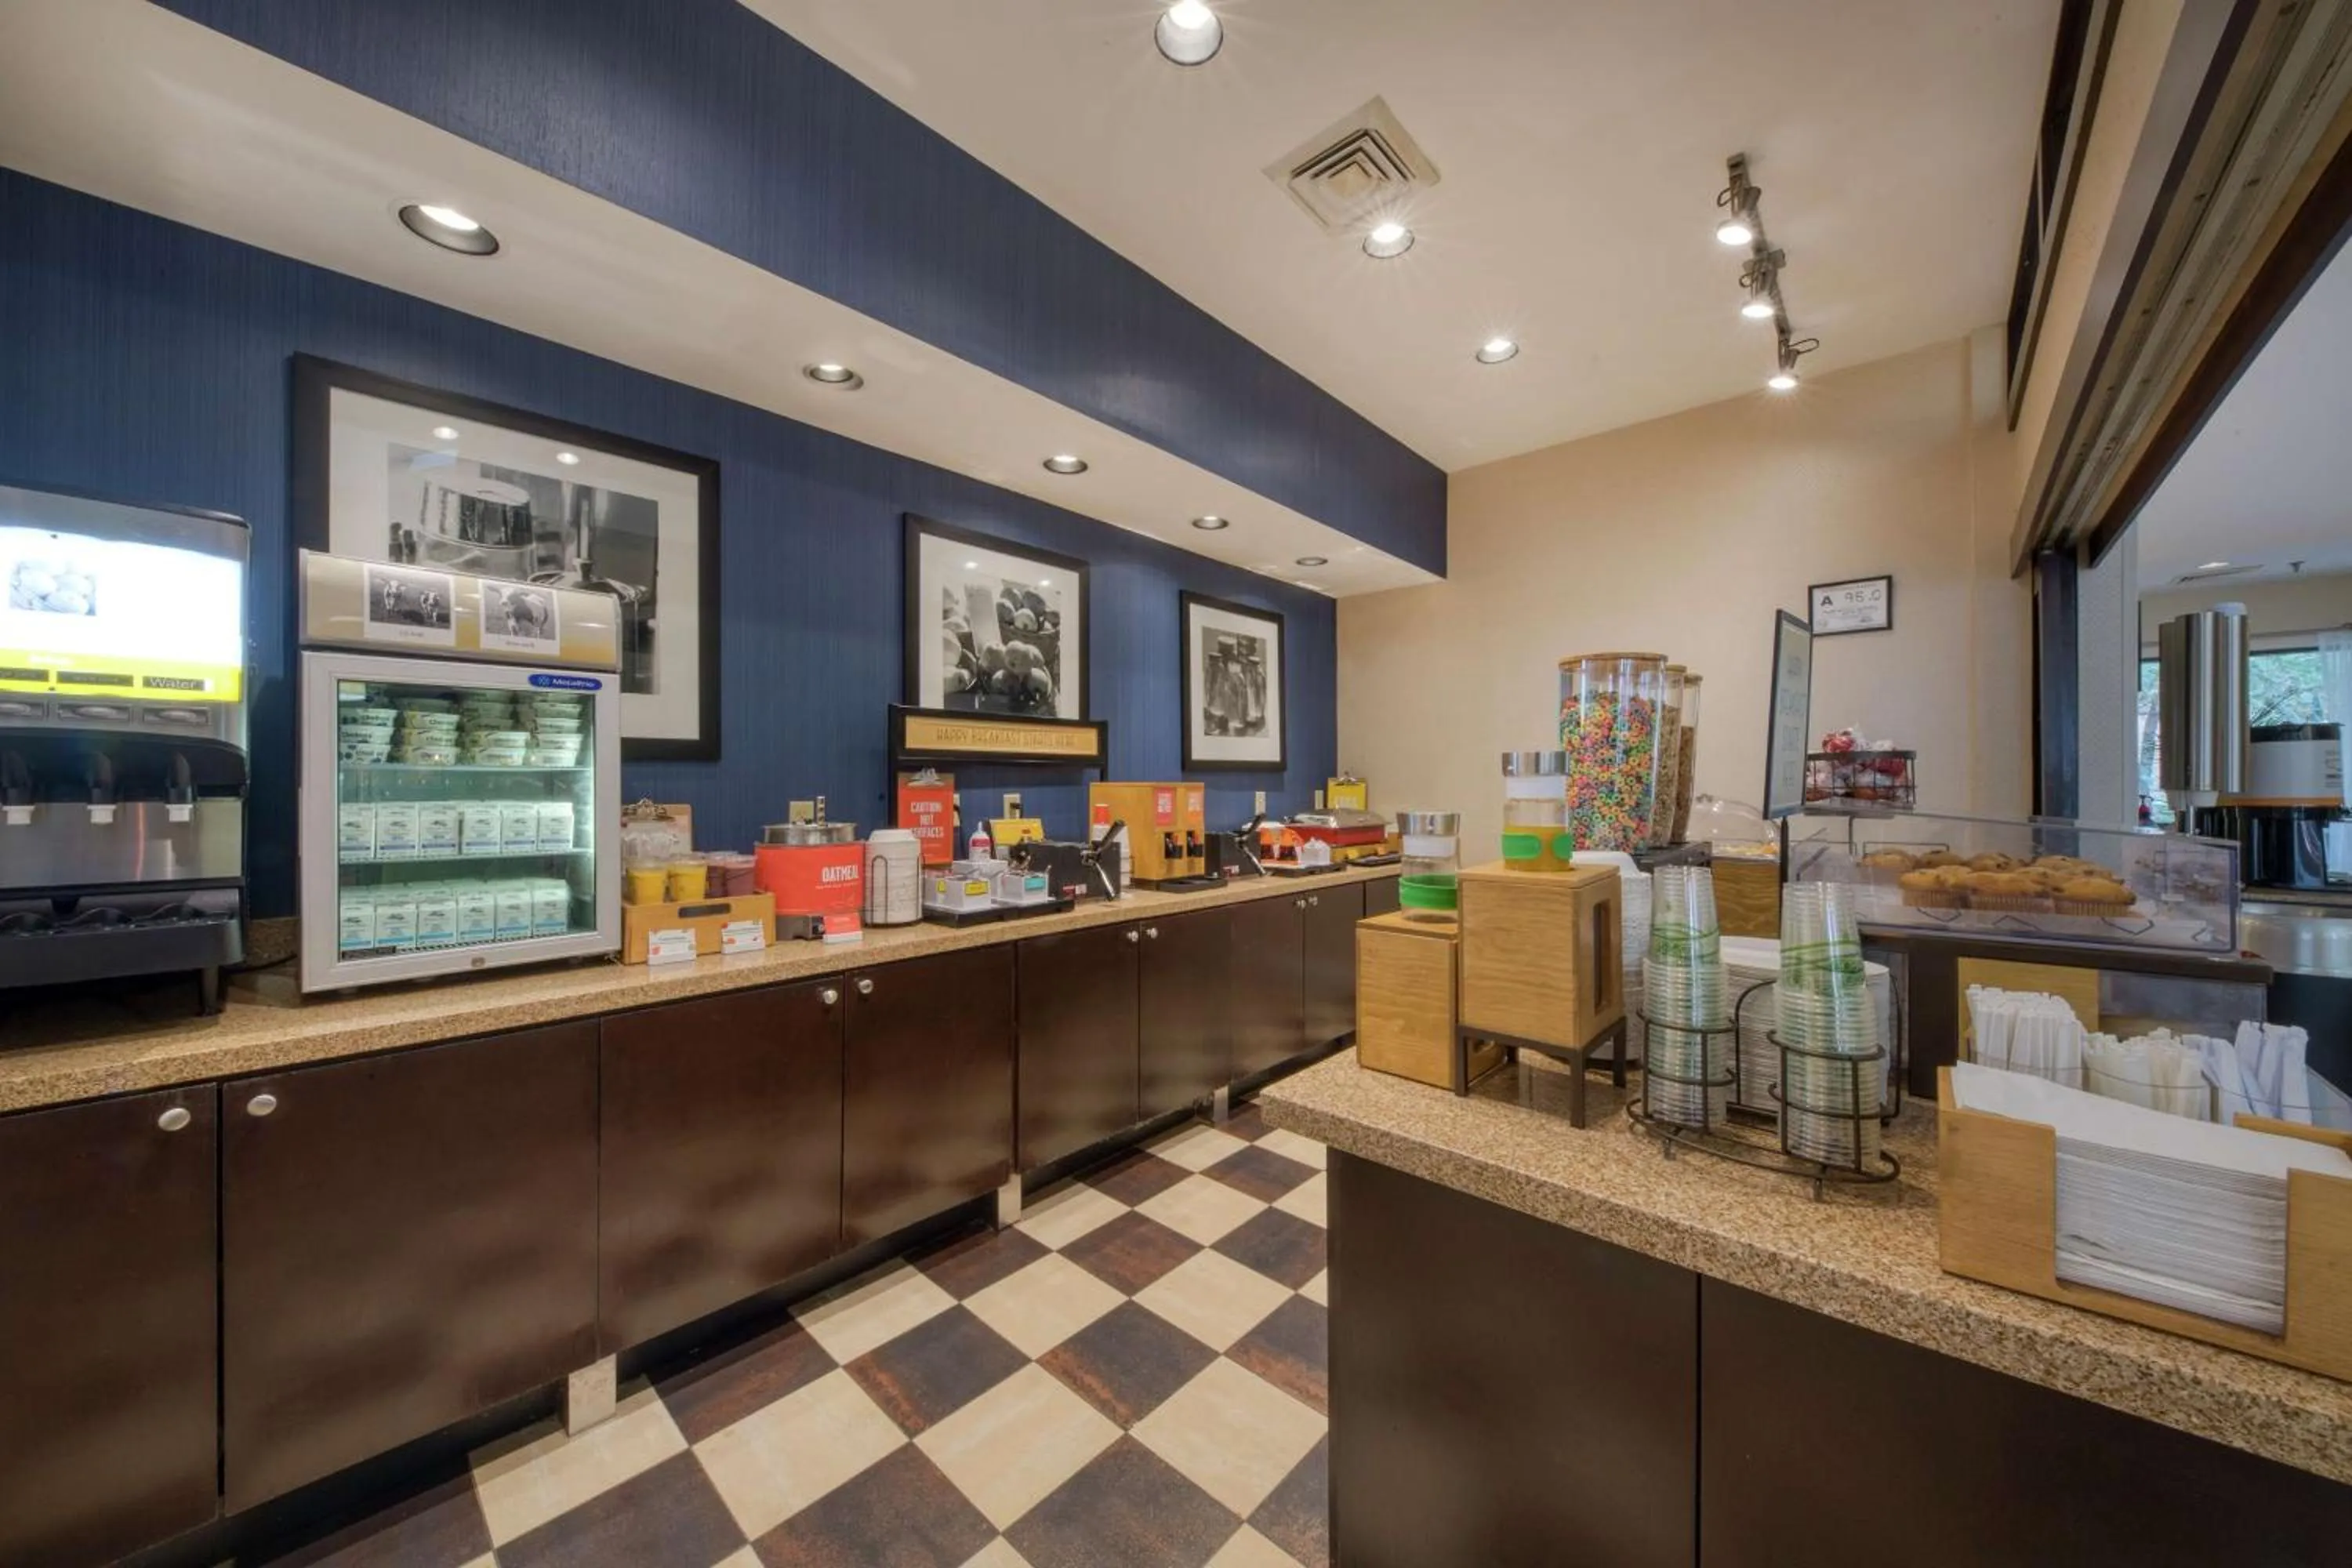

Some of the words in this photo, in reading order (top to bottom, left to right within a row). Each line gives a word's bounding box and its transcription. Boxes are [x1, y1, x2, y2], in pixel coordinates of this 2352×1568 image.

[1820, 595, 1833, 607] A
[150, 677, 195, 690] Water
[936, 728, 967, 742] HAPPY
[971, 729, 1022, 745] BREAKFAST
[910, 801, 942, 813] CAUTION
[920, 815, 934, 826] HOT
[821, 865, 859, 882] OATMEAL
